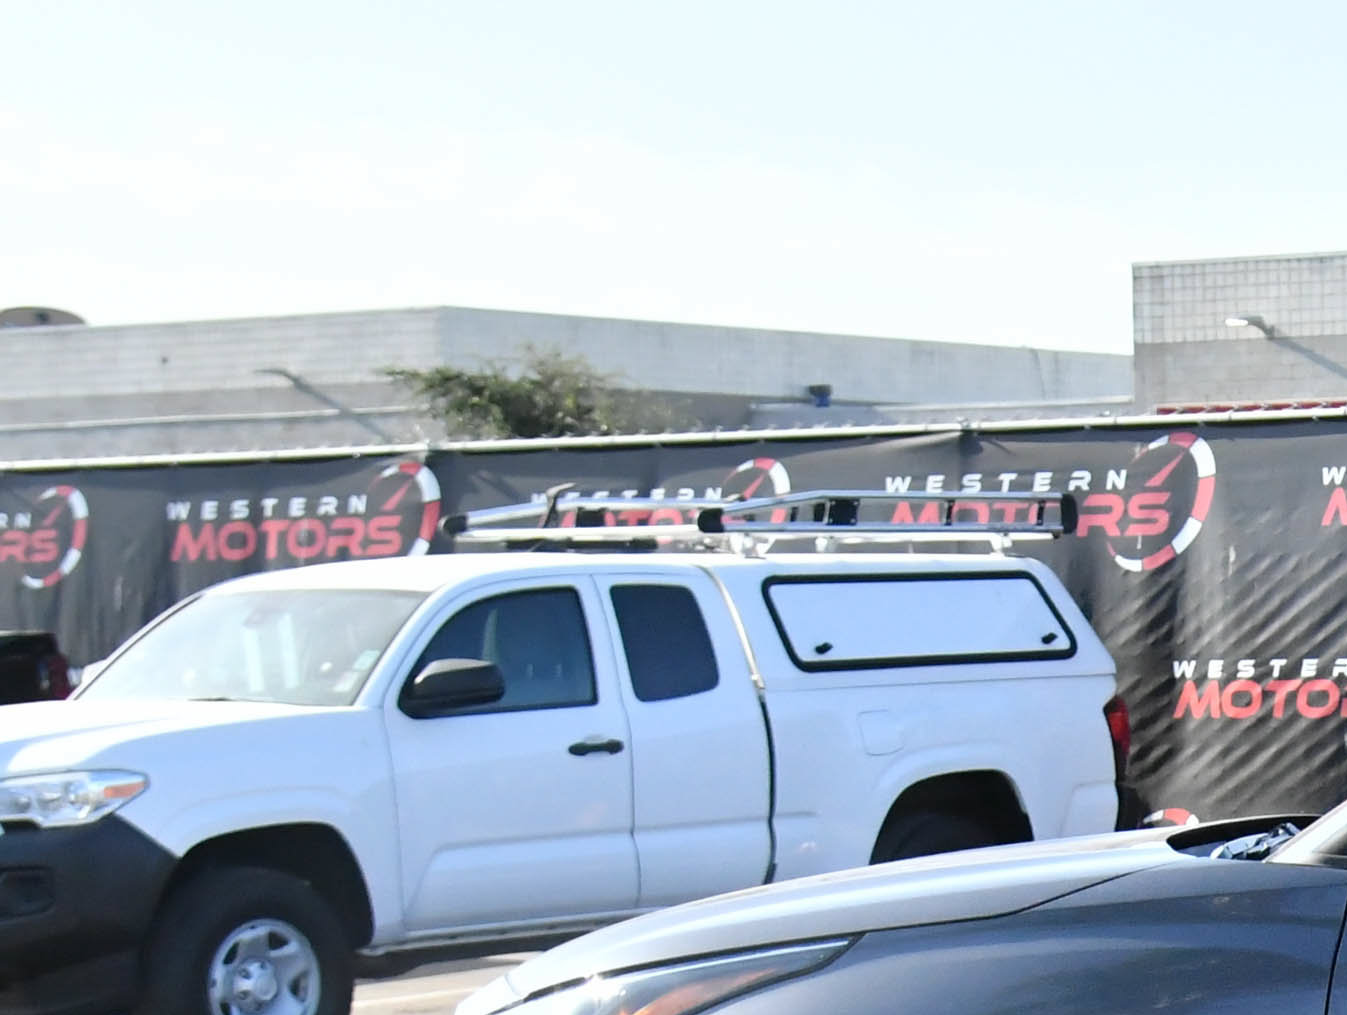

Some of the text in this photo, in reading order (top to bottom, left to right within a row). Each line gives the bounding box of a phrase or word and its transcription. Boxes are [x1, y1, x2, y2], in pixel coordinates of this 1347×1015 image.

[885, 470, 1126, 494] WESTERN
[170, 495, 366, 519] WESTERN
[173, 516, 400, 560] MOTORS
